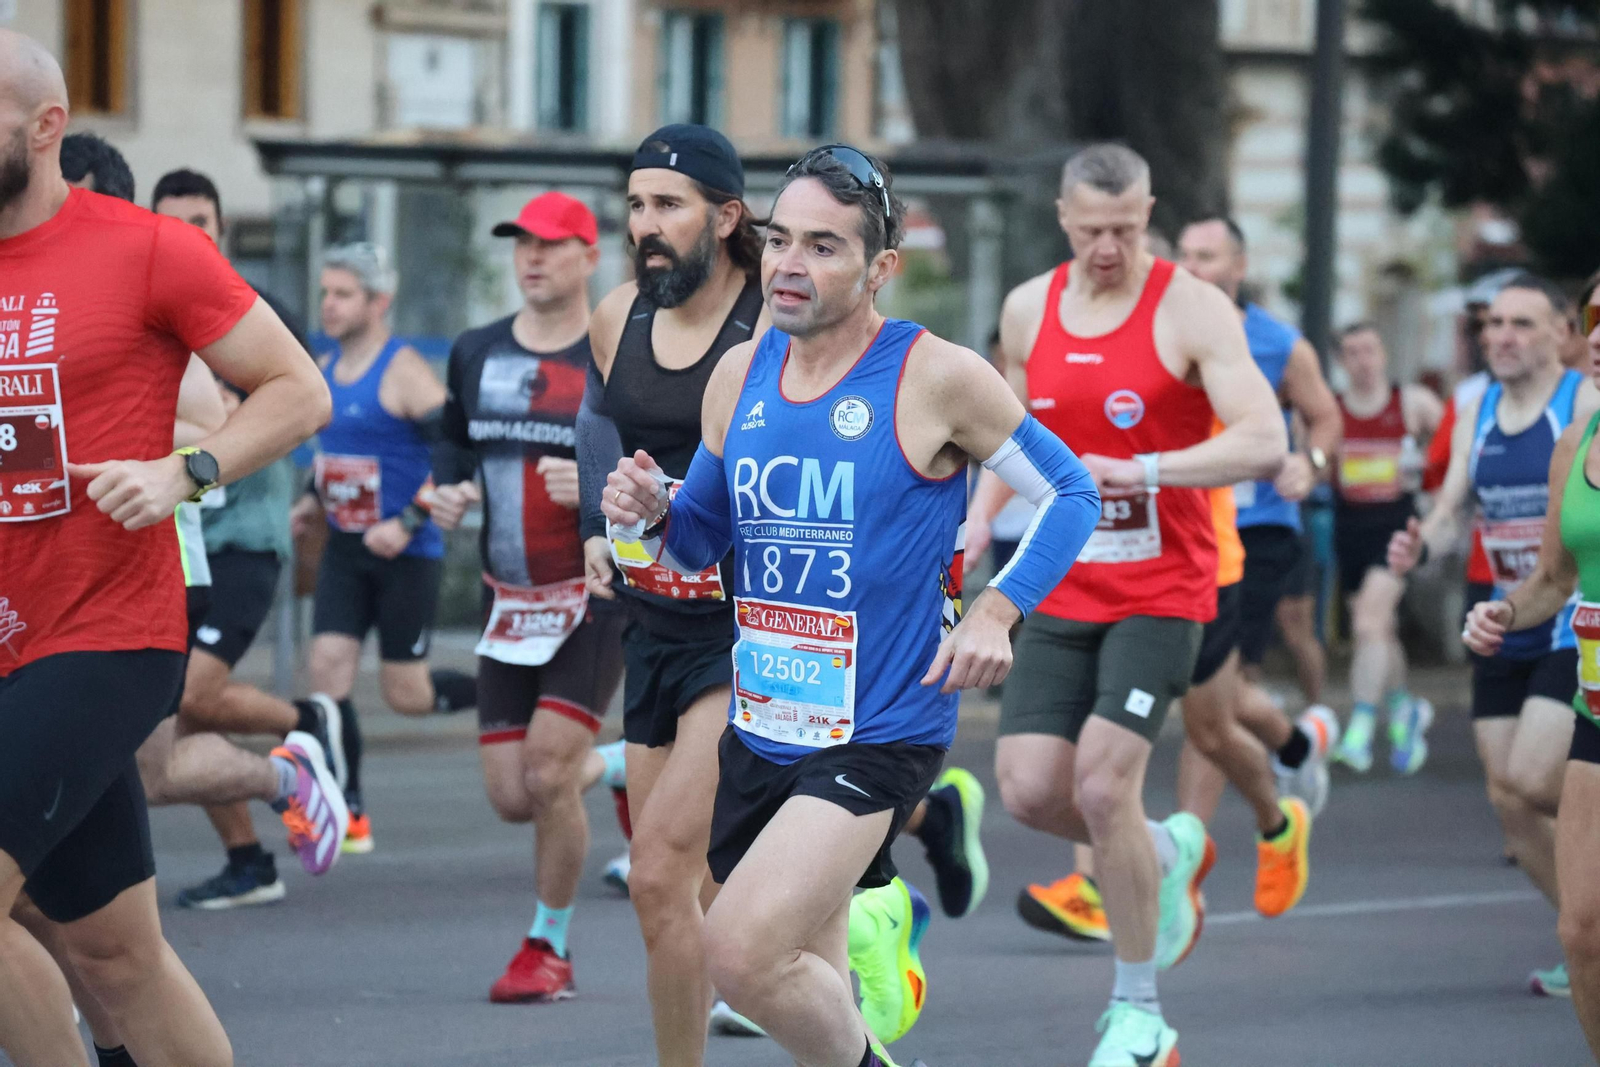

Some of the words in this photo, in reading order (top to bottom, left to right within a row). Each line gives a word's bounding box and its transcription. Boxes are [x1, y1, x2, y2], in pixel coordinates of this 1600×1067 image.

[838, 410, 866, 424] RCM
[12, 483, 43, 494] 42K
[734, 455, 855, 521] RCM
[754, 526, 778, 536] CLUB
[779, 527, 853, 541] MEDITERRANEO
[680, 575, 702, 584] 42K
[750, 651, 822, 685] 12502
[808, 715, 830, 725] 21K
